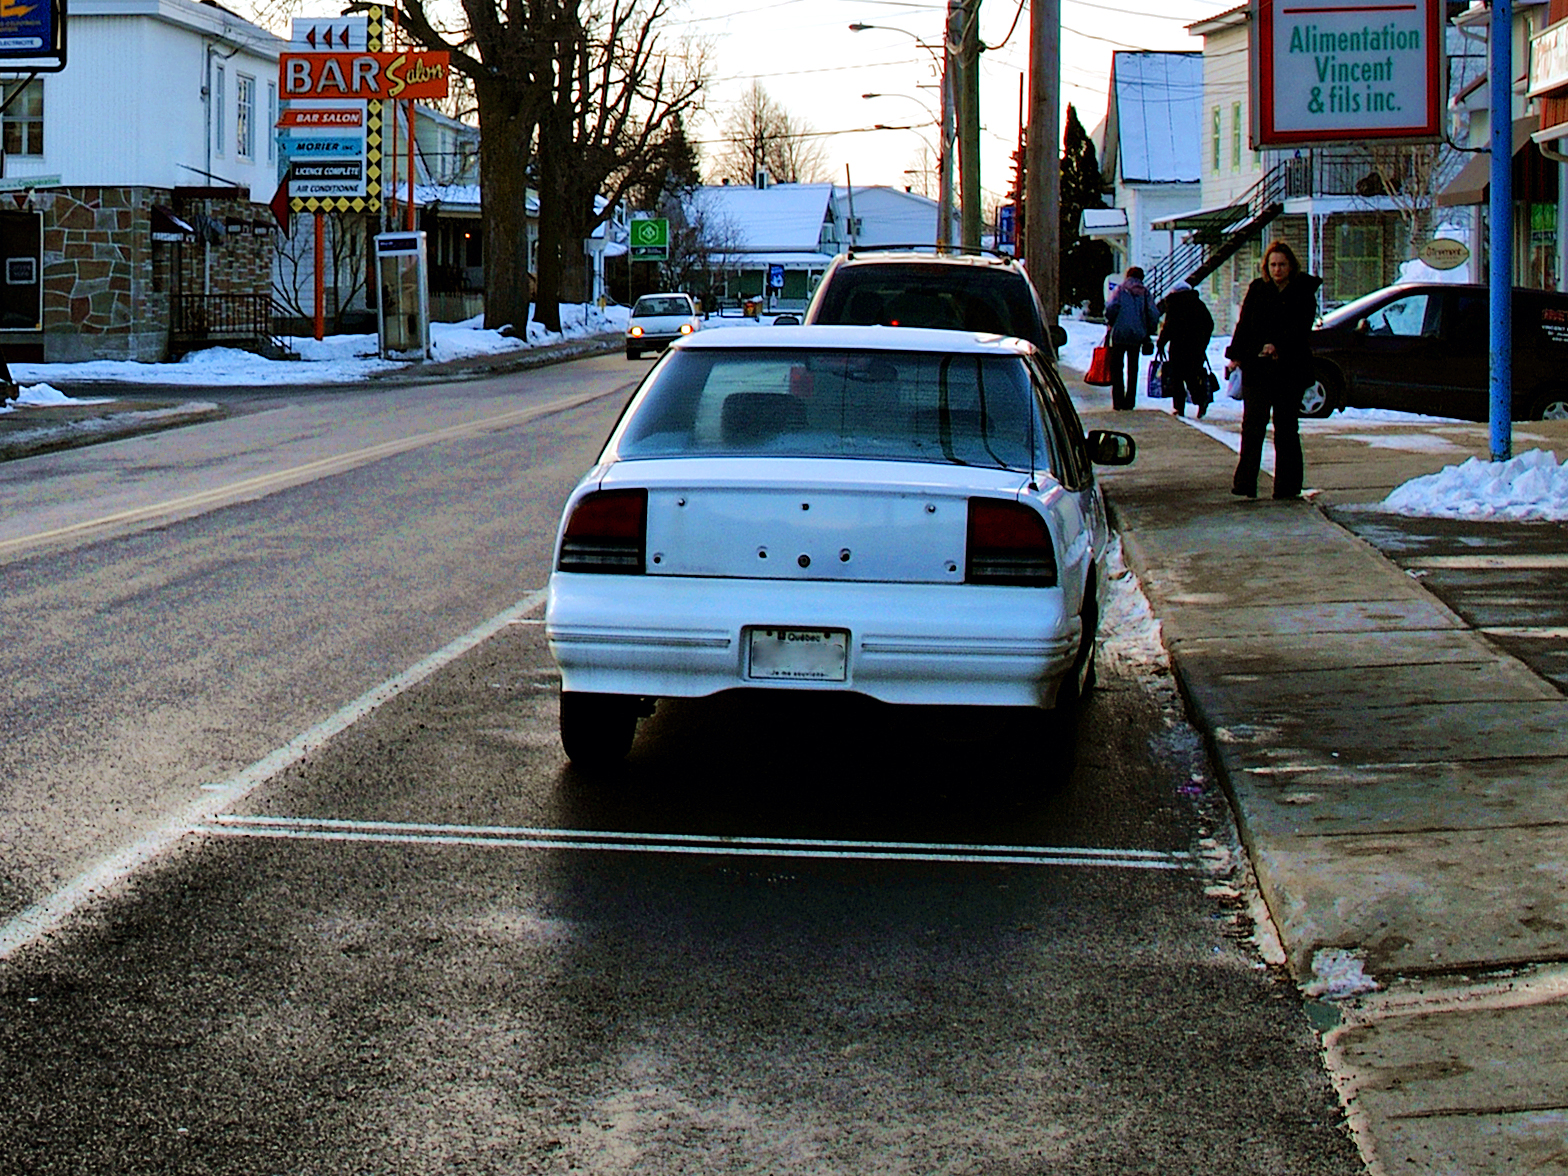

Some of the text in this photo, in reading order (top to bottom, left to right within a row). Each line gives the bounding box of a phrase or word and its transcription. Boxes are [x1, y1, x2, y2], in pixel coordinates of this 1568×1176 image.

[1289, 23, 1421, 54] Alimentation
[1314, 55, 1394, 83] Vincent
[286, 55, 445, 98] BAR Salon
[1307, 85, 1402, 114] & fils inc.
[296, 114, 361, 123] BAR SALON
[296, 143, 340, 151] MORIER
[295, 167, 323, 176] LICENCE
[295, 185, 310, 193] AIR
[787, 632, 822, 643] Québec
